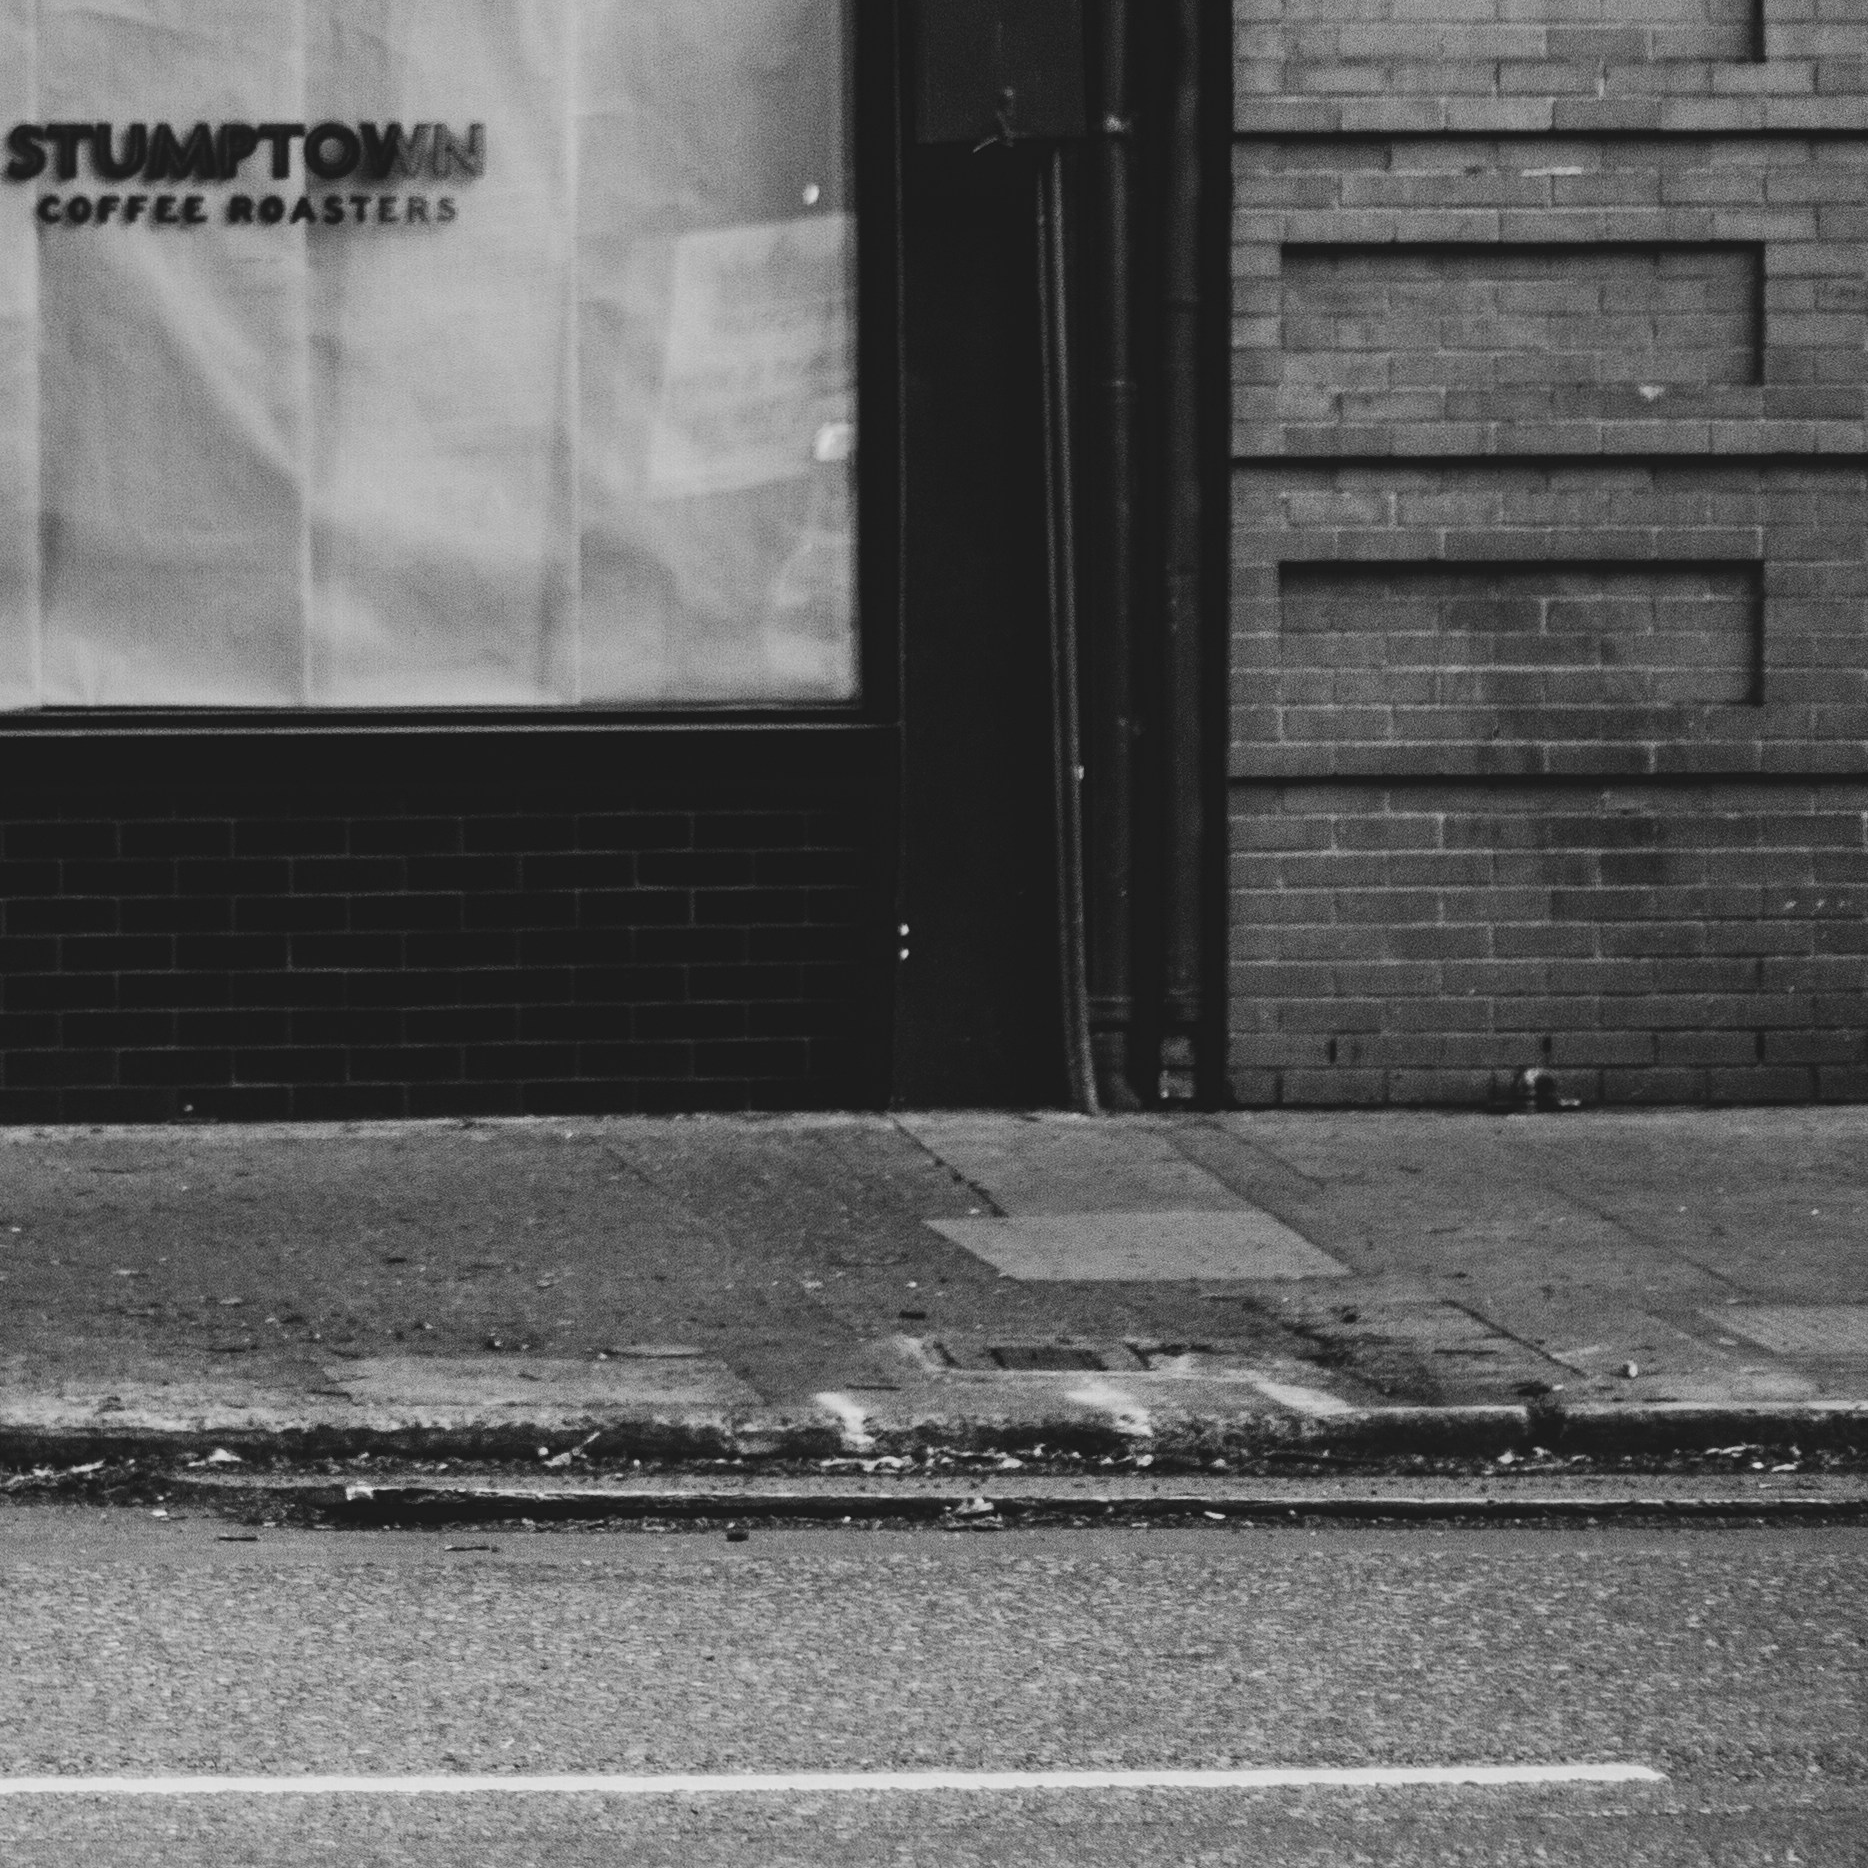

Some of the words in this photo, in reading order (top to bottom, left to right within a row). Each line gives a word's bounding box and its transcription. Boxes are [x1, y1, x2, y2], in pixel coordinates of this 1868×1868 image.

[6, 122, 485, 181] STUMPTOWN
[35, 194, 207, 225] COFFEE
[228, 195, 459, 225] ROASTERS
